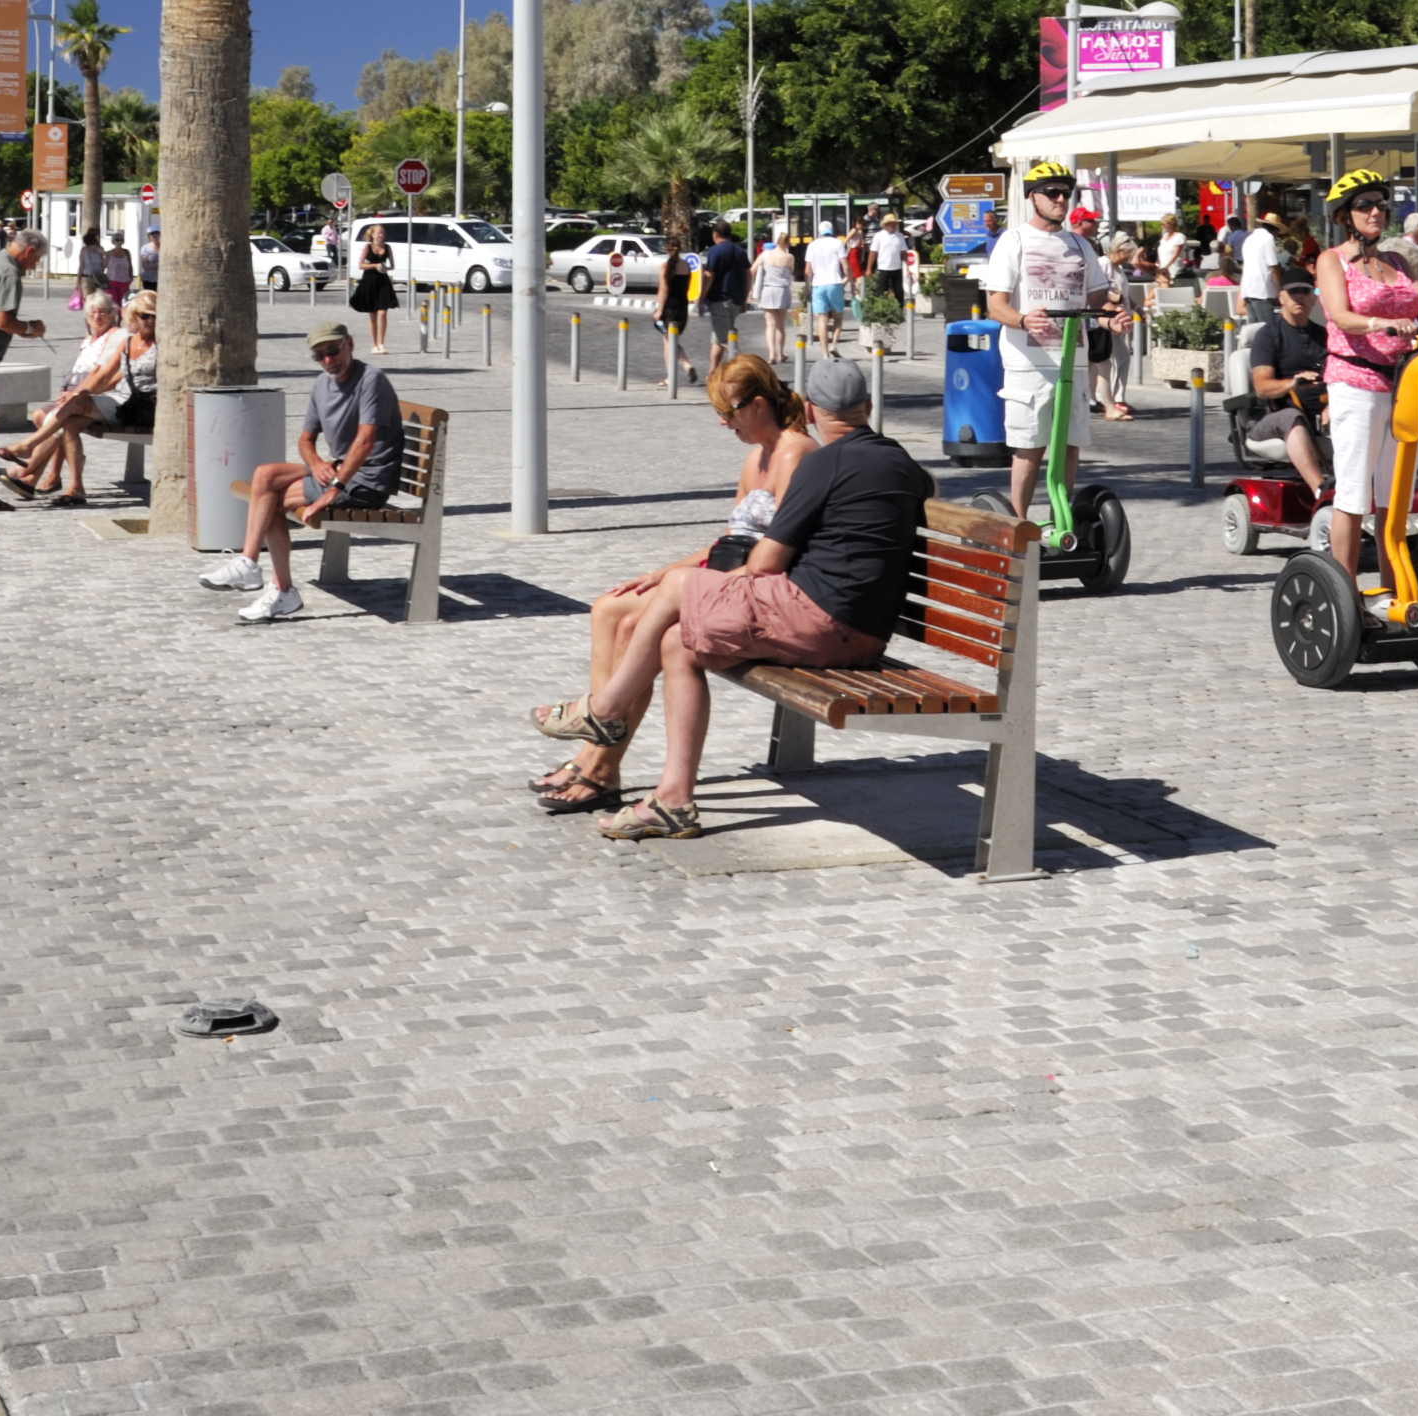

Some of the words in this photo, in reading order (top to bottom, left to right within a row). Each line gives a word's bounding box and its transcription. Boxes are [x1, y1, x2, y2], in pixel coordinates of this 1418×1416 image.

[1081, 35, 1161, 49] ΓΑΜΟΣ
[399, 169, 426, 185] STOP
[1028, 289, 1070, 302] PORTLAND
